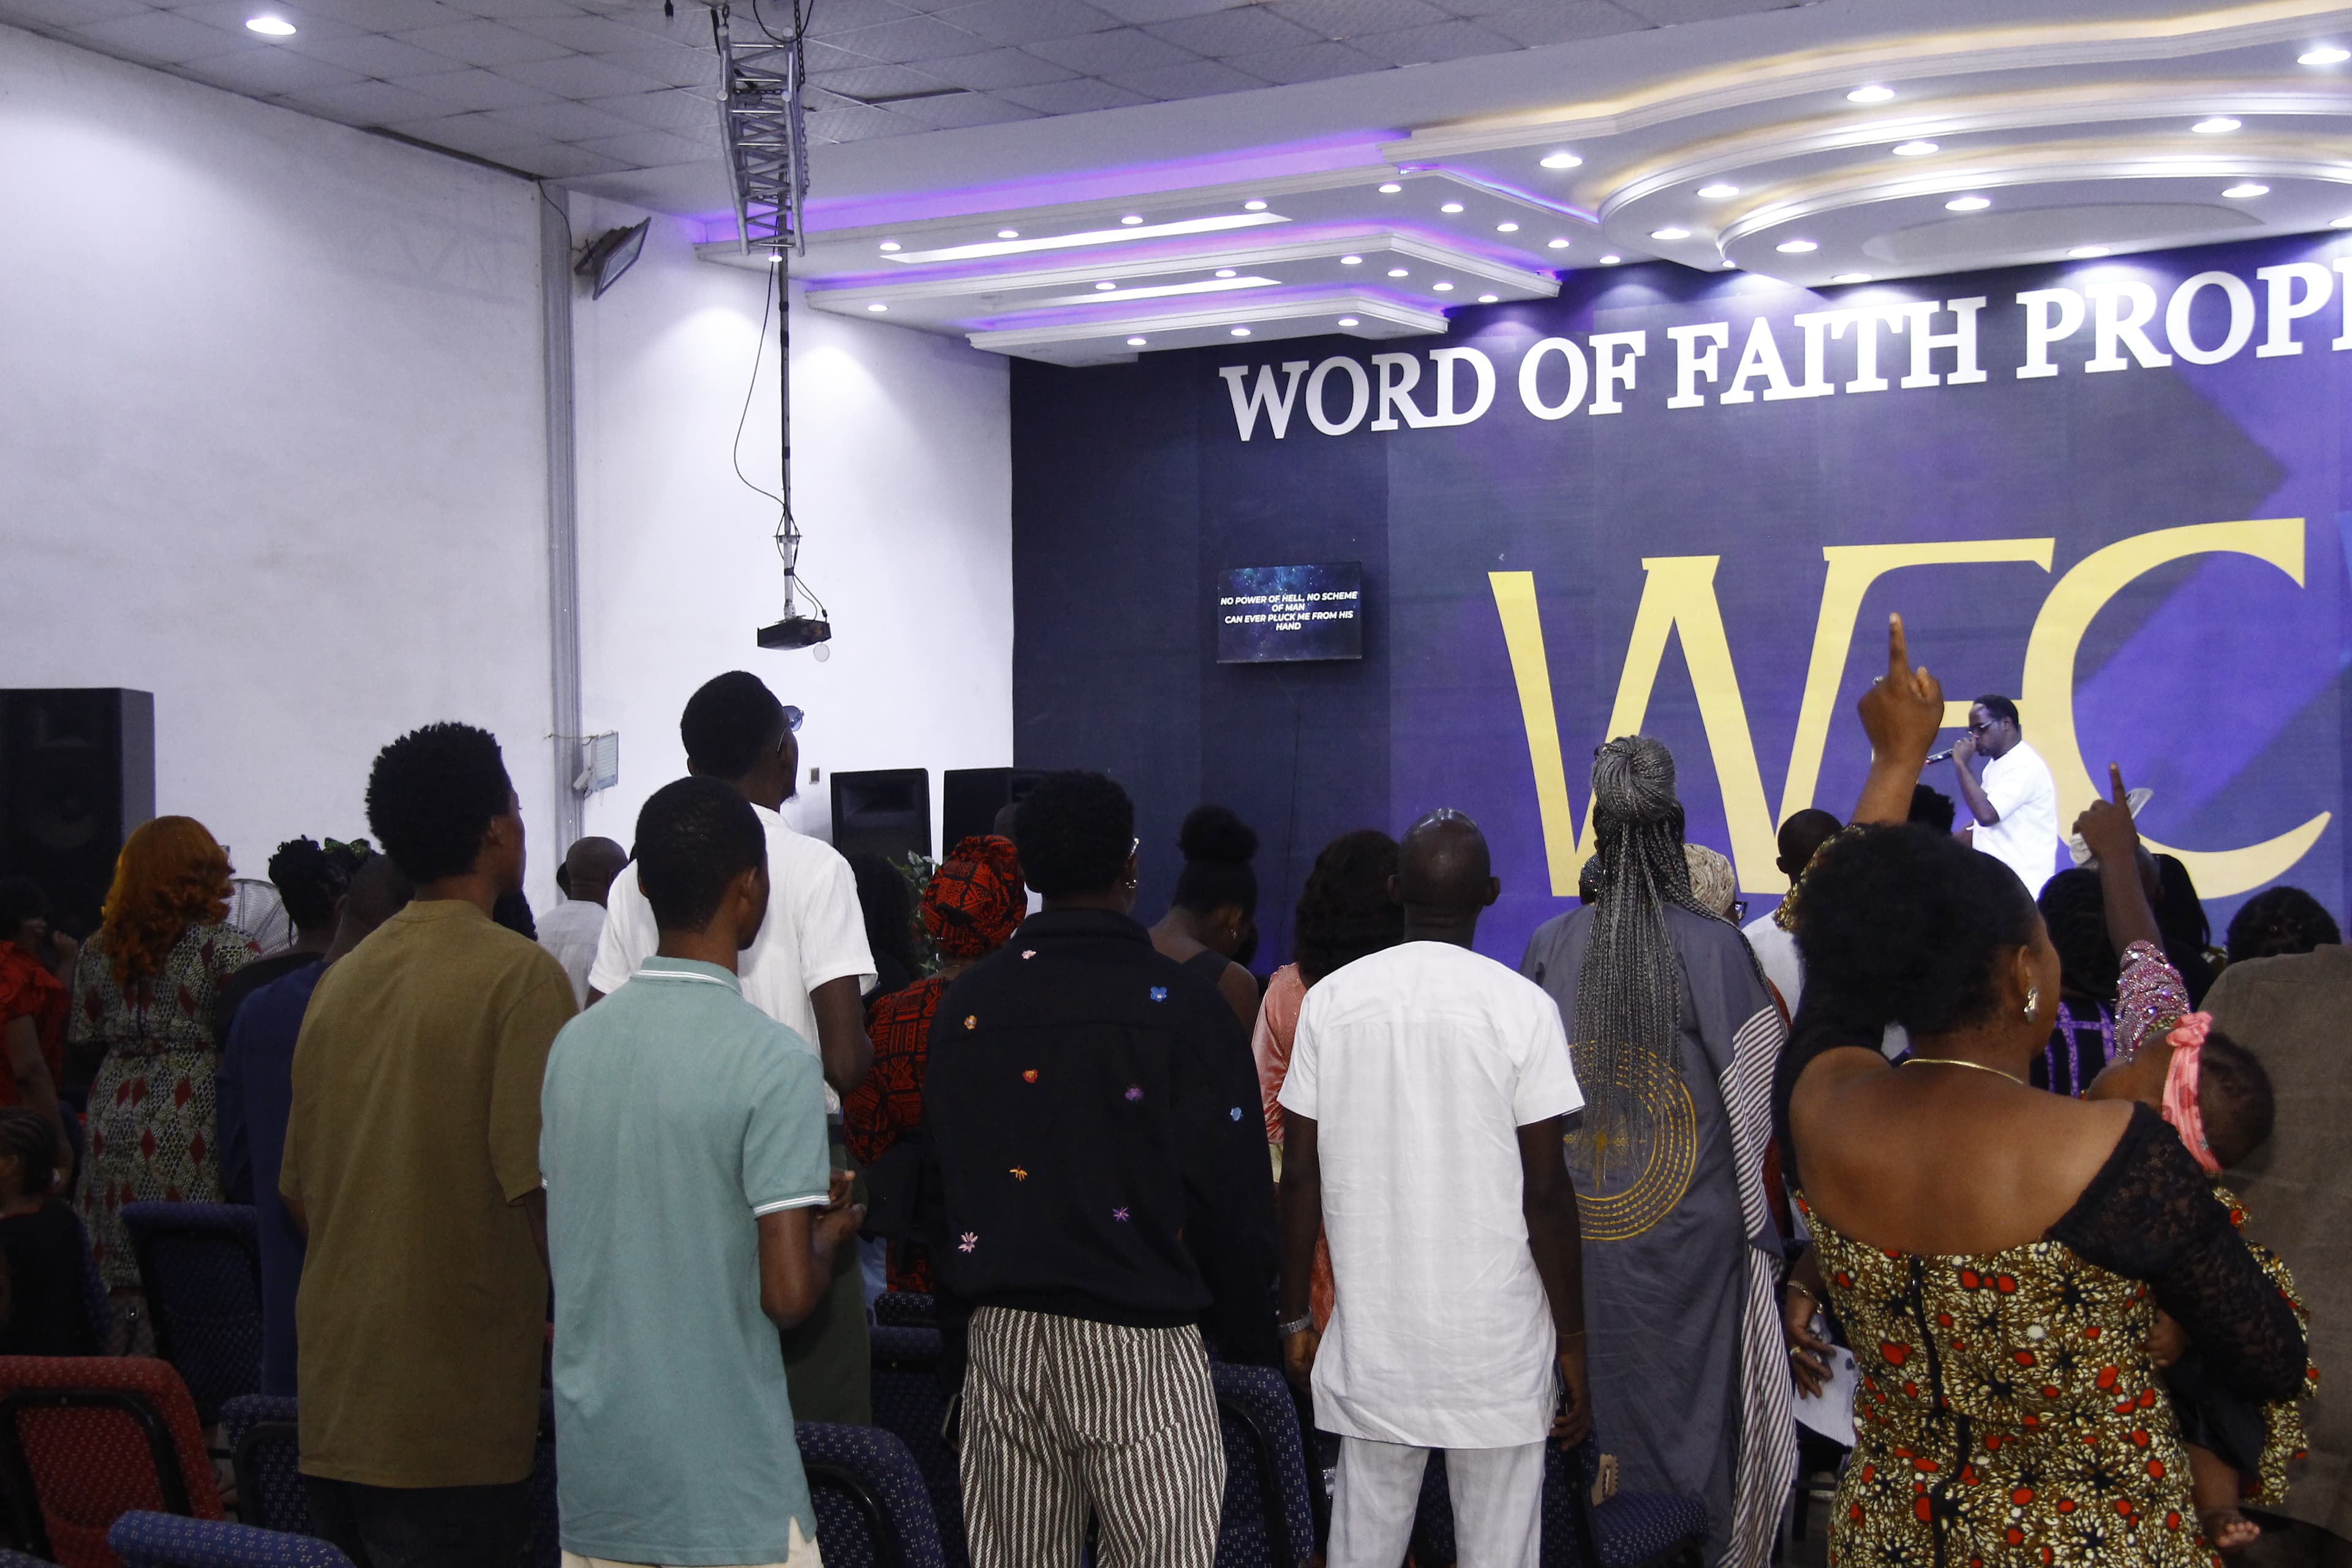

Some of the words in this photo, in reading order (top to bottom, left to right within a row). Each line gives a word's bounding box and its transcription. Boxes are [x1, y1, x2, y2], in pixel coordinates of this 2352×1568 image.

[1219, 345, 1496, 442] WORD
[1518, 330, 1646, 420] OF
[1667, 295, 1986, 409] FAITH
[1235, 595, 1267, 605] POWER
[1282, 594, 1305, 603] HELL,
[1306, 592, 1321, 601] NO
[1322, 591, 1358, 600] SCHEME
[1285, 603, 1305, 611] MAN
[1244, 614, 1266, 623] EVER
[1268, 613, 1296, 622] PLUCK
[1297, 612, 1310, 620] ME
[1312, 611, 1337, 620] FROM
[1276, 622, 1302, 630] HAND
